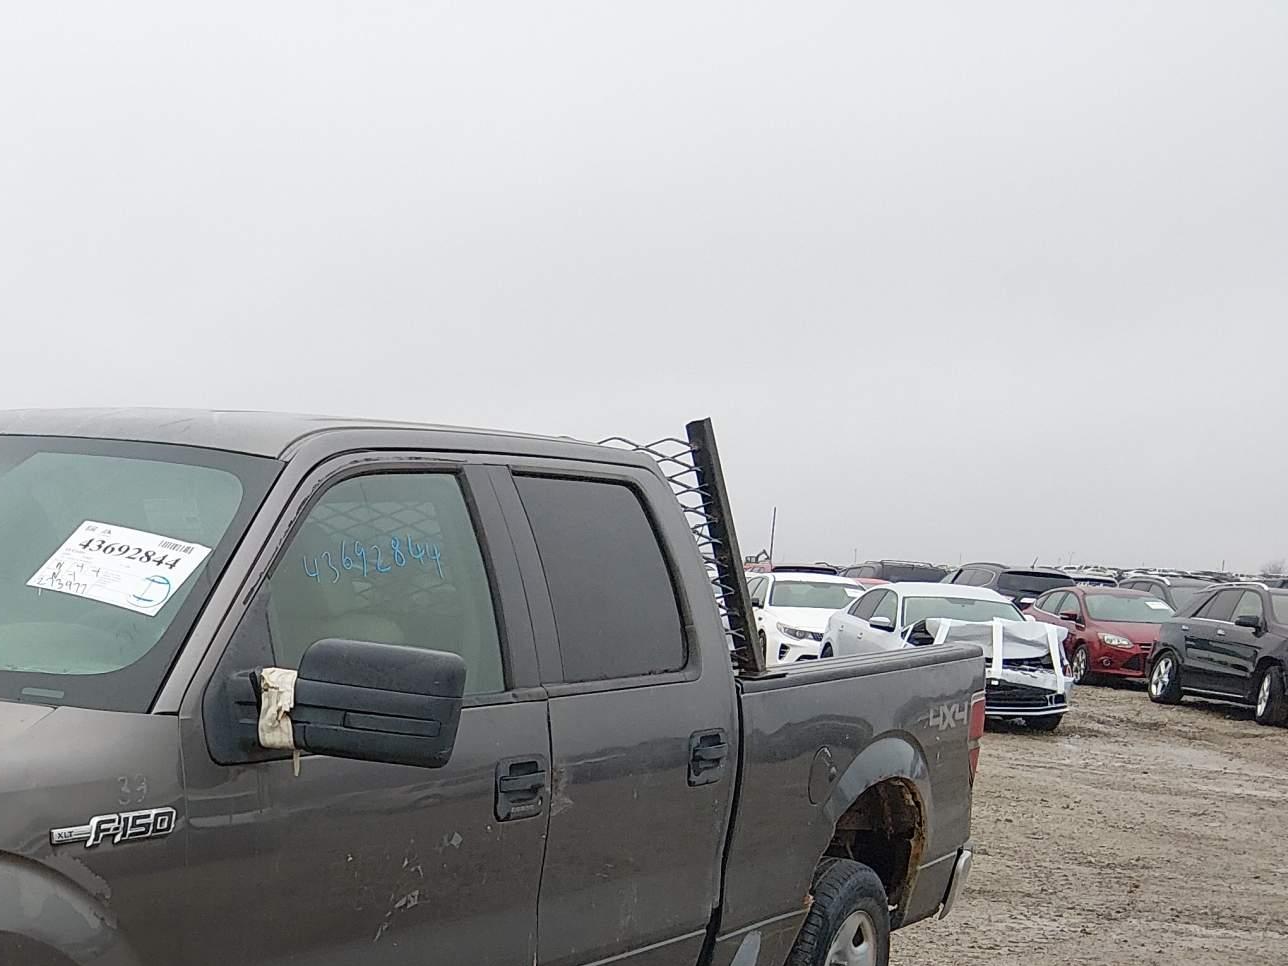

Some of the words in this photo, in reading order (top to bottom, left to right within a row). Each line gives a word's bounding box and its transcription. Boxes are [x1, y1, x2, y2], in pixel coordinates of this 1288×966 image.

[78, 537, 182, 570] 43692844
[303, 535, 445, 583] 43692844
[57, 831, 74, 839] XLT
